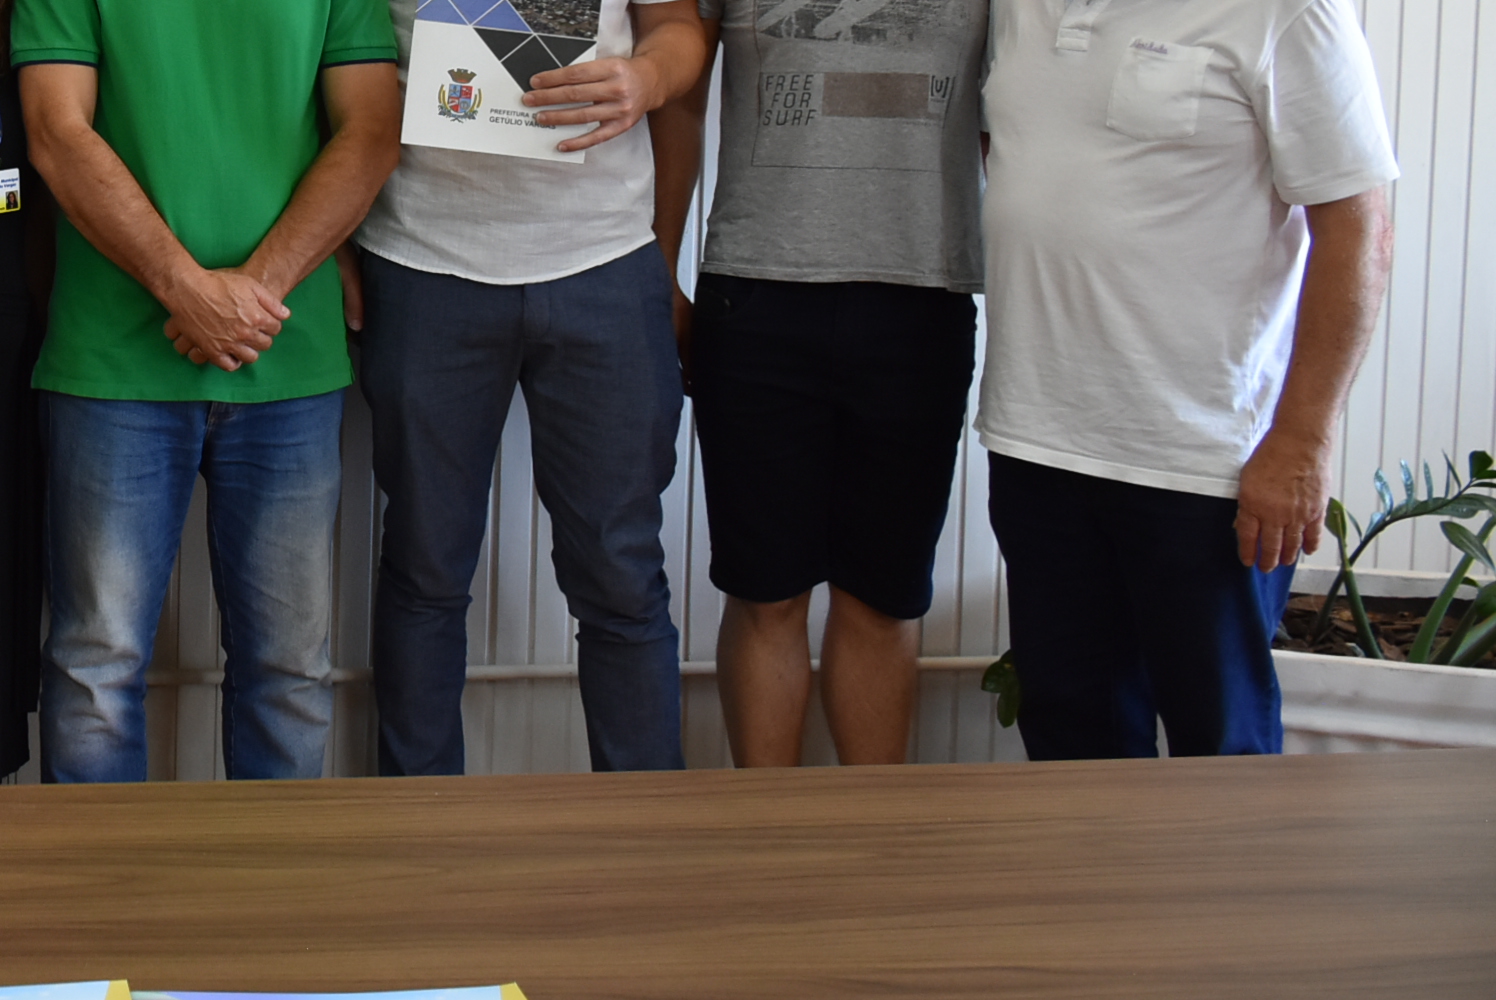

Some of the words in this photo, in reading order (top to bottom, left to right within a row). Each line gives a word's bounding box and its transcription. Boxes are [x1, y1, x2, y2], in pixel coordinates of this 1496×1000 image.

[765, 74, 814, 91] FREE
[771, 92, 811, 108] FOR
[489, 116, 523, 126] GETÚLIO
[490, 108, 529, 118] PREFEITURA
[762, 109, 816, 126] SURF
